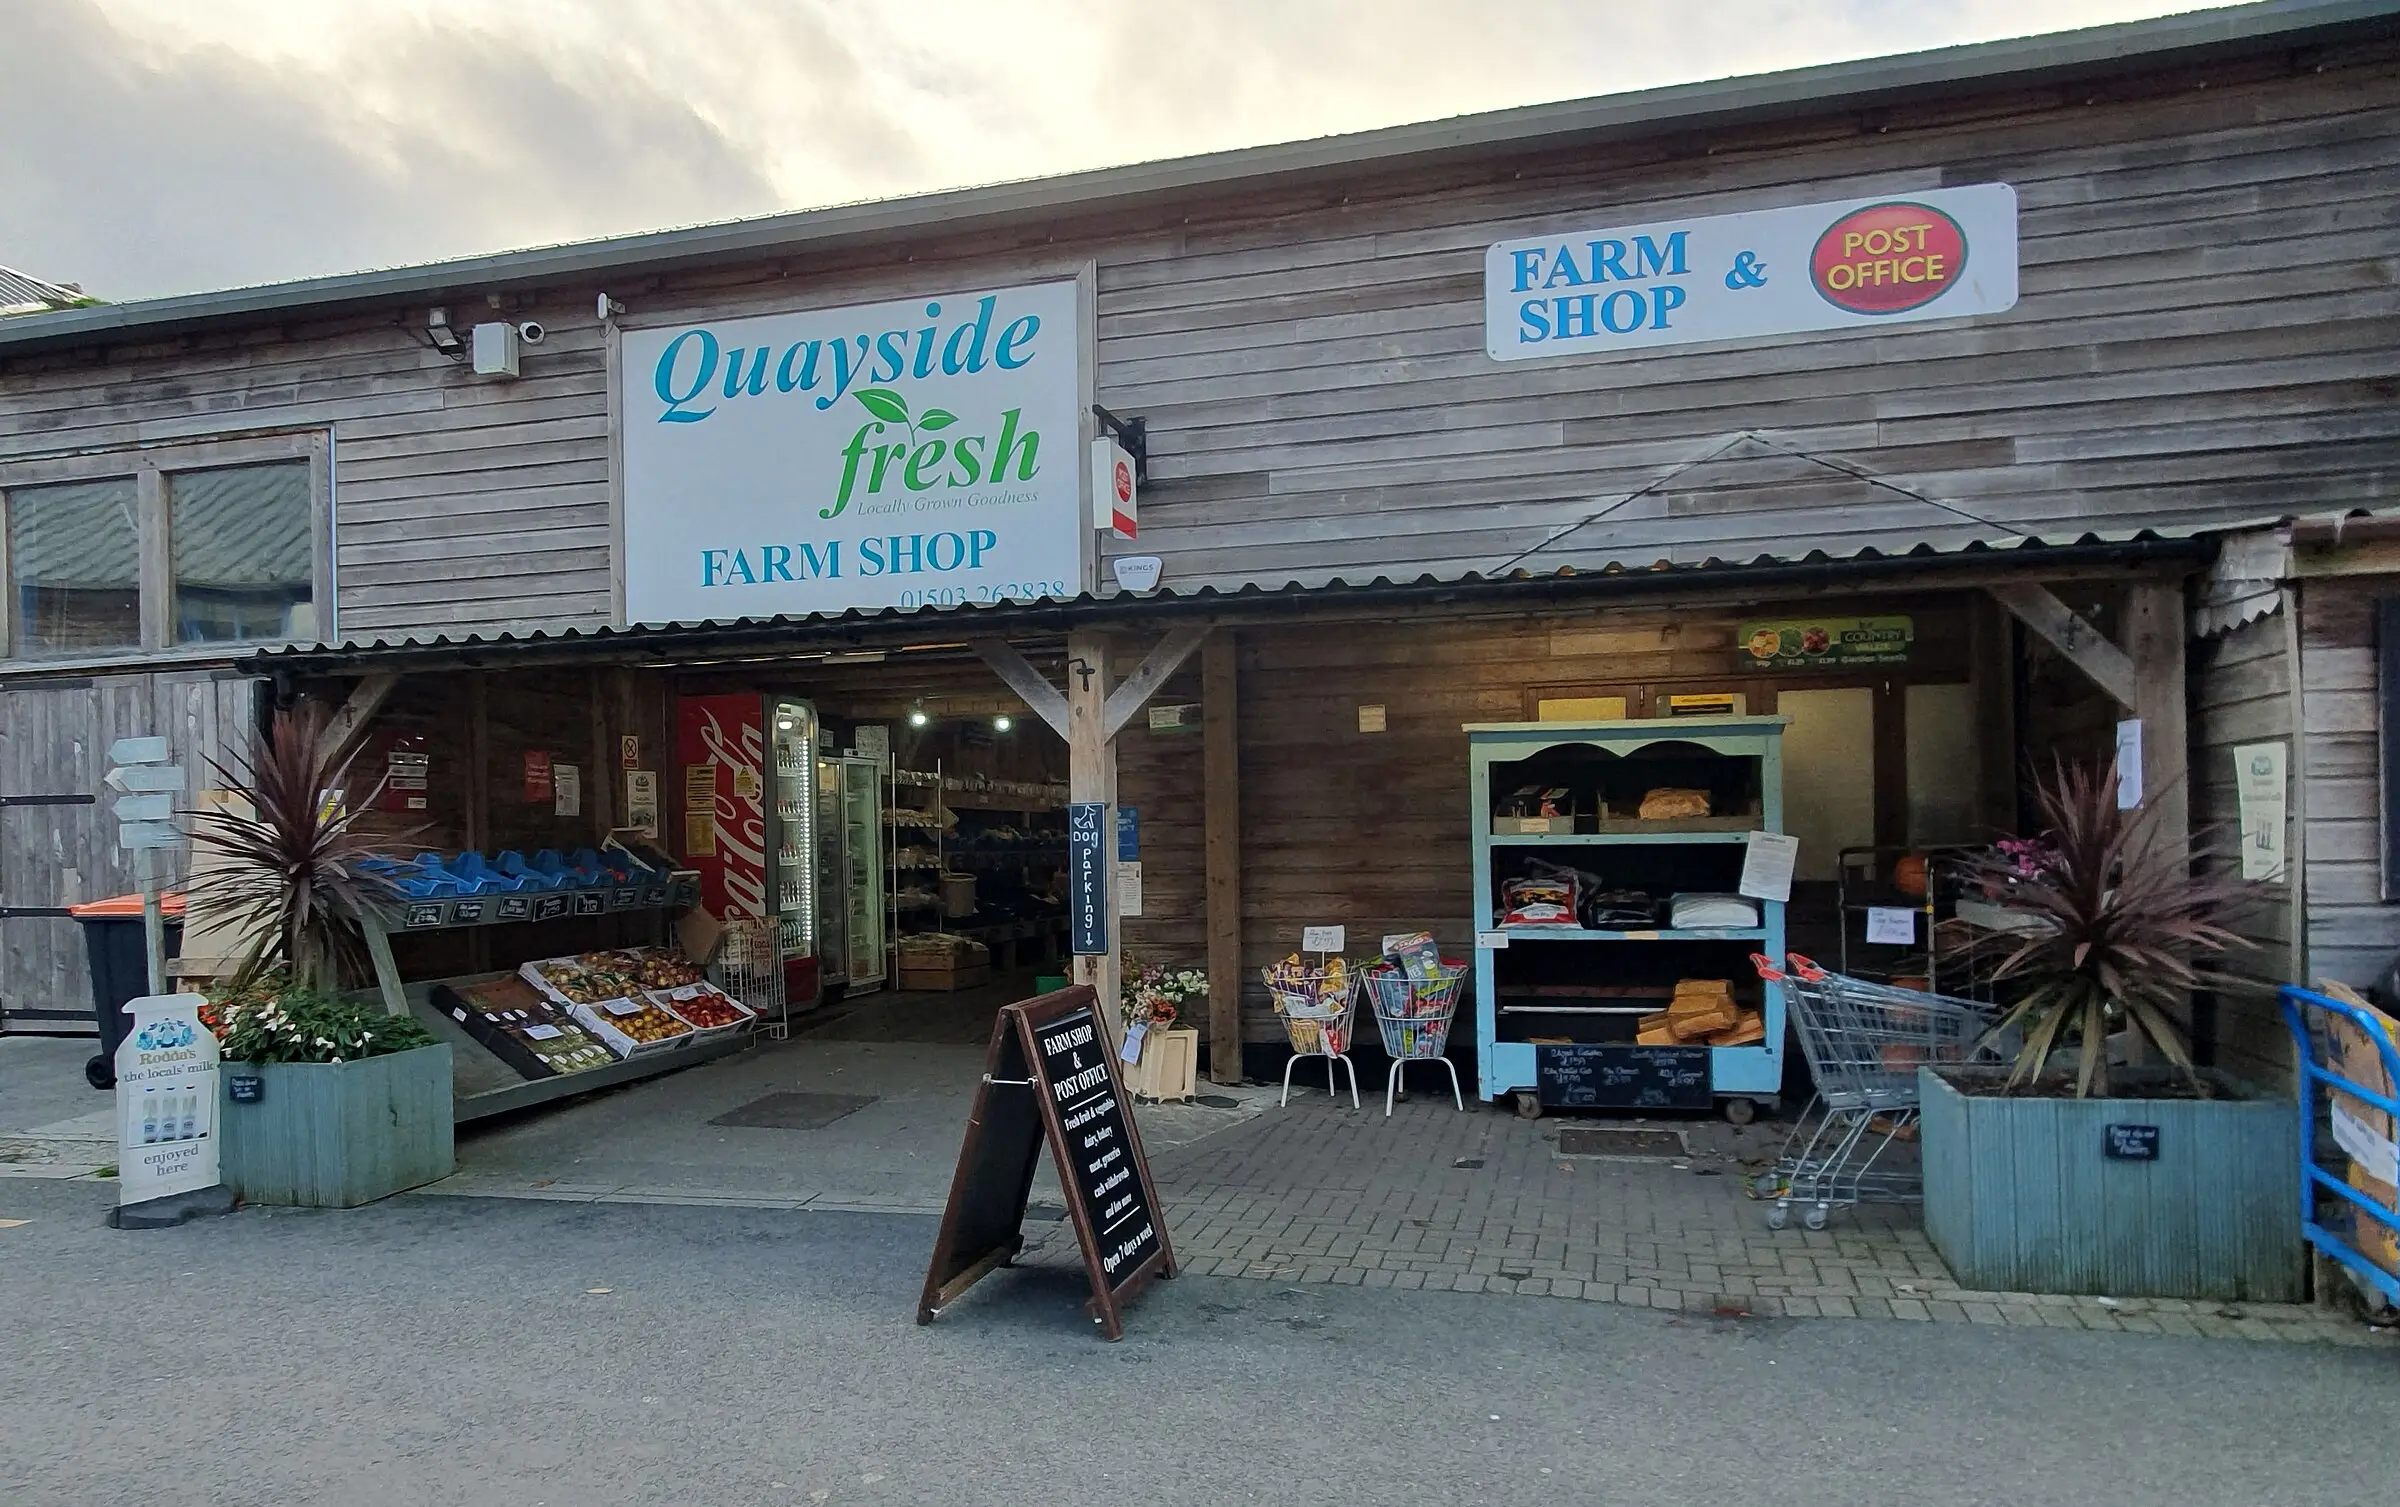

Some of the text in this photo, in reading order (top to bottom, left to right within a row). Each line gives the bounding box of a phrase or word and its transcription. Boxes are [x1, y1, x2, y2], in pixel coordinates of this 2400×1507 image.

[1842, 223, 1934, 258] POST
[1510, 230, 1691, 293] FARM
[1724, 249, 1769, 291] &
[1826, 254, 1945, 291] OFFICE
[1518, 285, 1686, 344] SHOP
[653, 294, 1042, 424] Quayside
[818, 407, 1042, 520] fresh
[857, 490, 1039, 516] Locally Grown Goodness
[701, 529, 998, 588] FARM SHOP
[1127, 563, 1154, 572] KINGS
[901, 580, 1065, 608] 01503 262838
[1073, 828, 1099, 849] Dog
[1043, 1024, 1093, 1057] FARM SHOP
[123, 1060, 215, 1083] the locals' milk
[138, 1050, 197, 1066] Rodda's
[1072, 1051, 1083, 1070] &
[1053, 1062, 1109, 1102] POST OFFICE
[1064, 1114, 1081, 1131] Fresh
[1078, 1109, 1092, 1124] fruit
[143, 1143, 199, 1167] enjoyed
[156, 1160, 189, 1177] here
[1103, 1252, 1121, 1274] Open
[1118, 1244, 1125, 1261] 7
[1123, 1241, 1138, 1256] days
[1139, 1222, 1154, 1242] week
